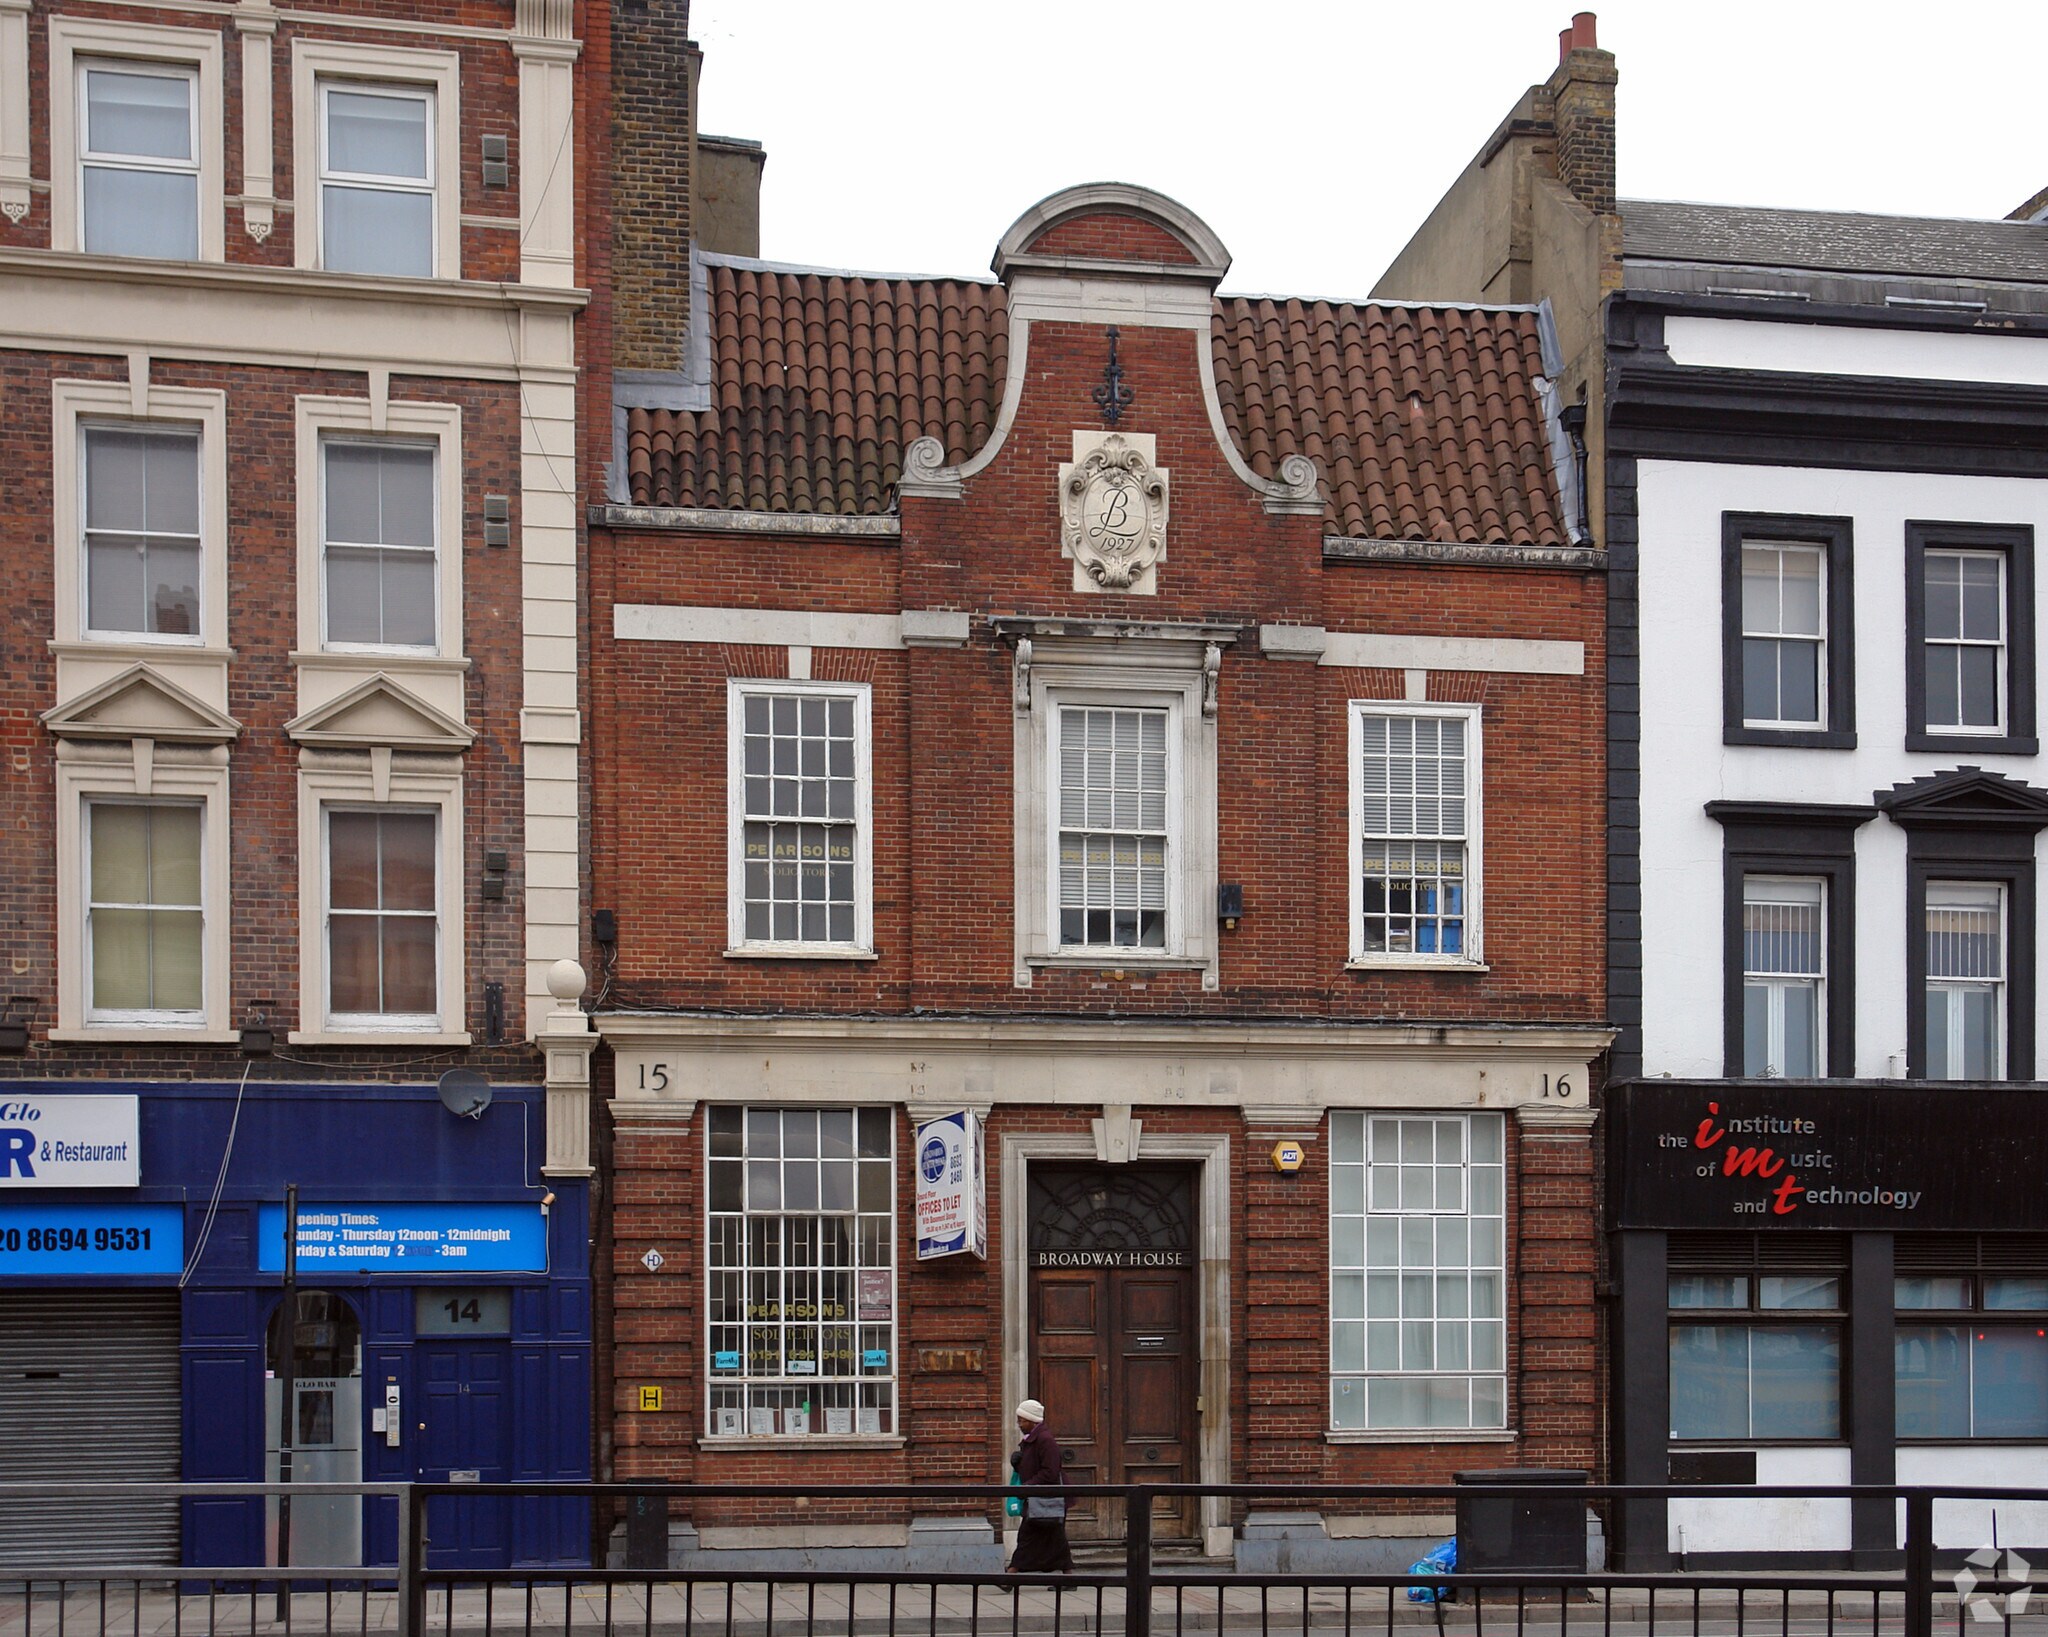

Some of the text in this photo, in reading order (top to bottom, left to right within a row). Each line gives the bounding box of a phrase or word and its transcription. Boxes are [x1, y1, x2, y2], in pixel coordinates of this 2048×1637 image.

[1099, 537, 1135, 551] 1927
[747, 844, 850, 857] PEARSONS
[1364, 860, 1461, 873] PEARSONS
[639, 1064, 668, 1091] 15
[1543, 1073, 1571, 1097] 16
[0, 1102, 41, 1121] Glo
[1658, 1133, 1688, 1148] the
[40, 1141, 51, 1161] &
[55, 1141, 128, 1161] Restaurant
[1283, 1152, 1298, 1160] ADT
[1696, 1162, 1716, 1177] of
[918, 1194, 961, 1216] OFFICES TO LET
[1733, 1198, 1767, 1214] and
[296, 1213, 379, 1226] pening Times:
[27, 1228, 88, 1251] 8694
[95, 1228, 152, 1251] 9531
[342, 1228, 395, 1241] Thursday
[397, 1229, 438, 1241] 12noon
[446, 1228, 511, 1242] 12midnight
[296, 1244, 327, 1257] riday
[328, 1245, 337, 1256] &
[338, 1244, 390, 1257] Saturday
[441, 1244, 467, 1256] 3am
[647, 1254, 660, 1266] HD
[1039, 1253, 1182, 1265] BROADWAY HOUSE
[444, 1298, 481, 1323] 14
[748, 1304, 845, 1317] PEARSONS
[753, 1328, 851, 1340] SOLICITORS
[459, 1383, 470, 1393] 14
[643, 1389, 658, 1407] H
